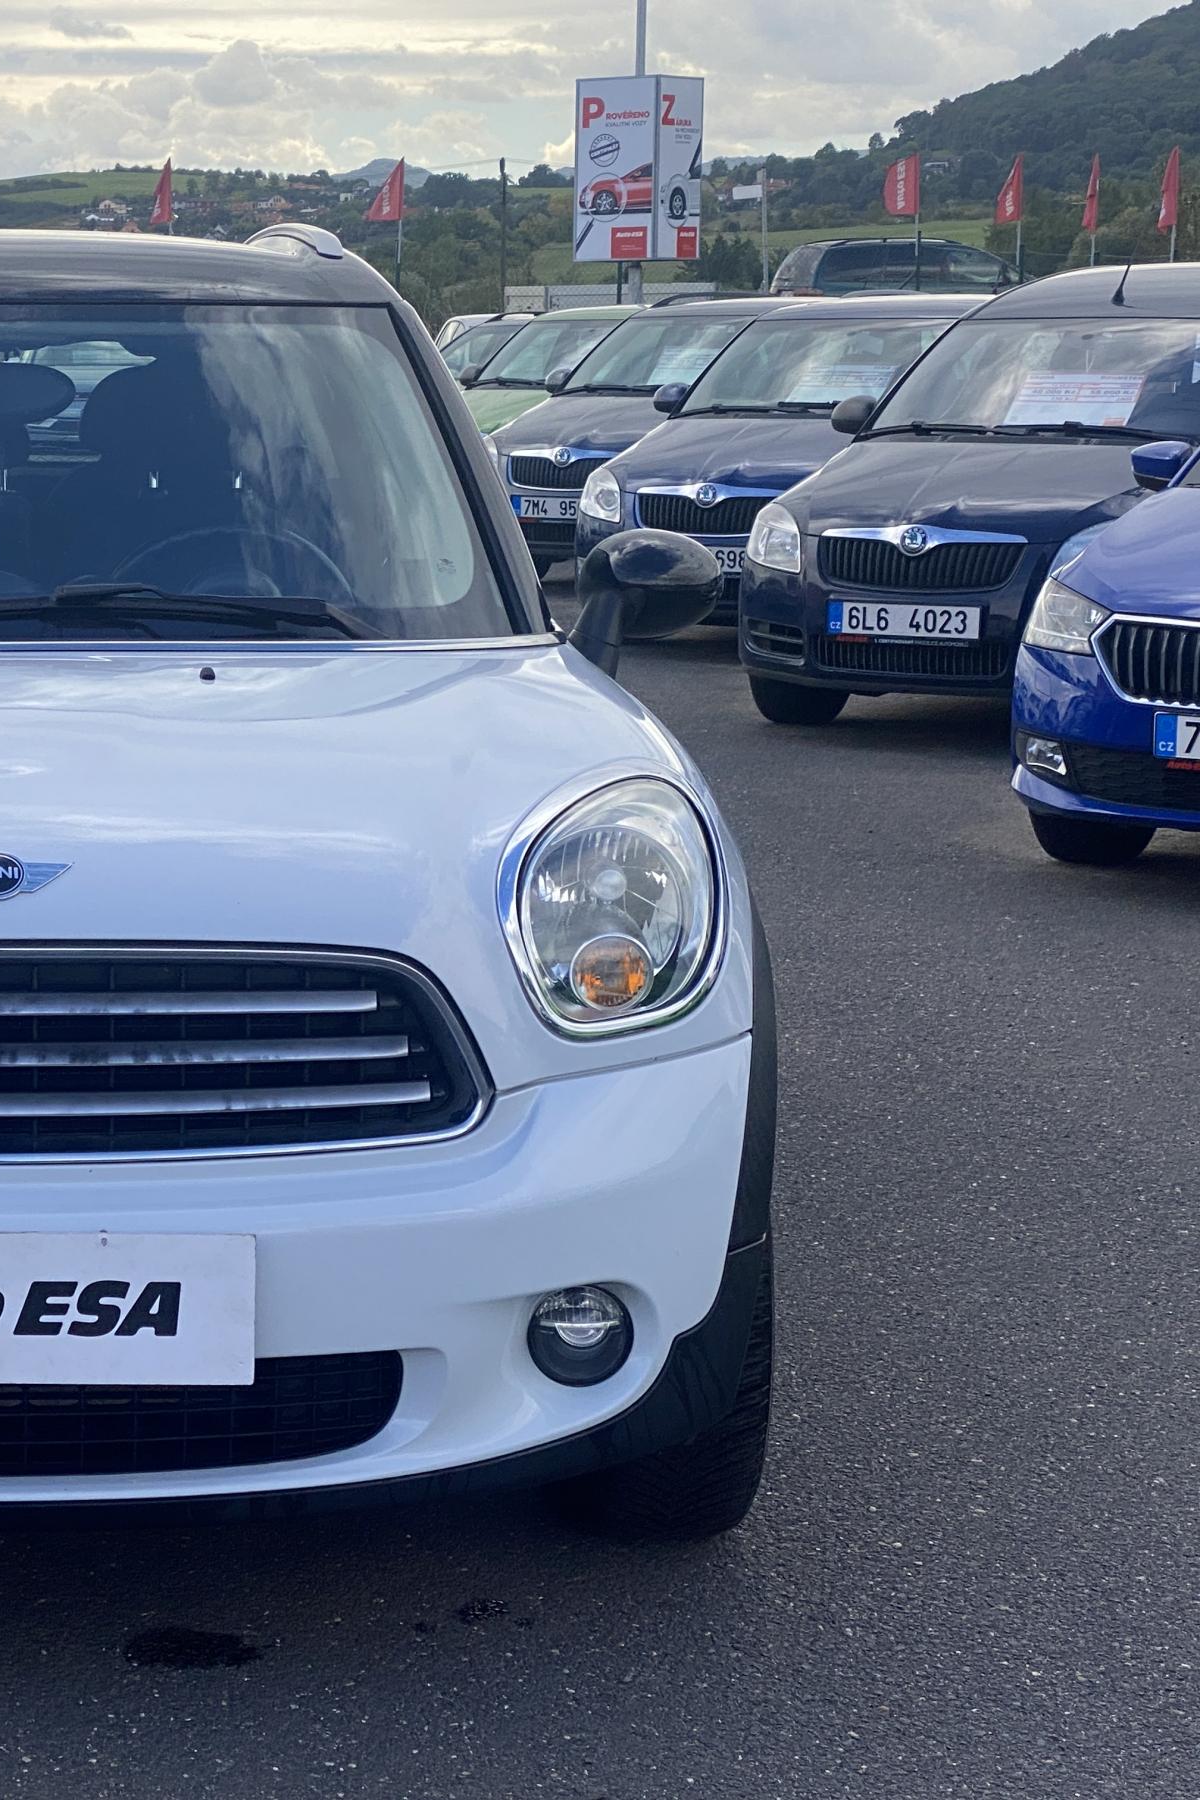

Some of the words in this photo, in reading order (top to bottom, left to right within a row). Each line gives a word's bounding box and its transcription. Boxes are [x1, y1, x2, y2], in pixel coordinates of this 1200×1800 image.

[524, 500, 548, 515] 7M4
[560, 501, 577, 516] 95
[830, 621, 841, 629] CZ
[848, 606, 889, 631] 6L6
[909, 608, 967, 634] 4023
[1159, 741, 1174, 752] CZ
[13, 1280, 182, 1338] ESA
